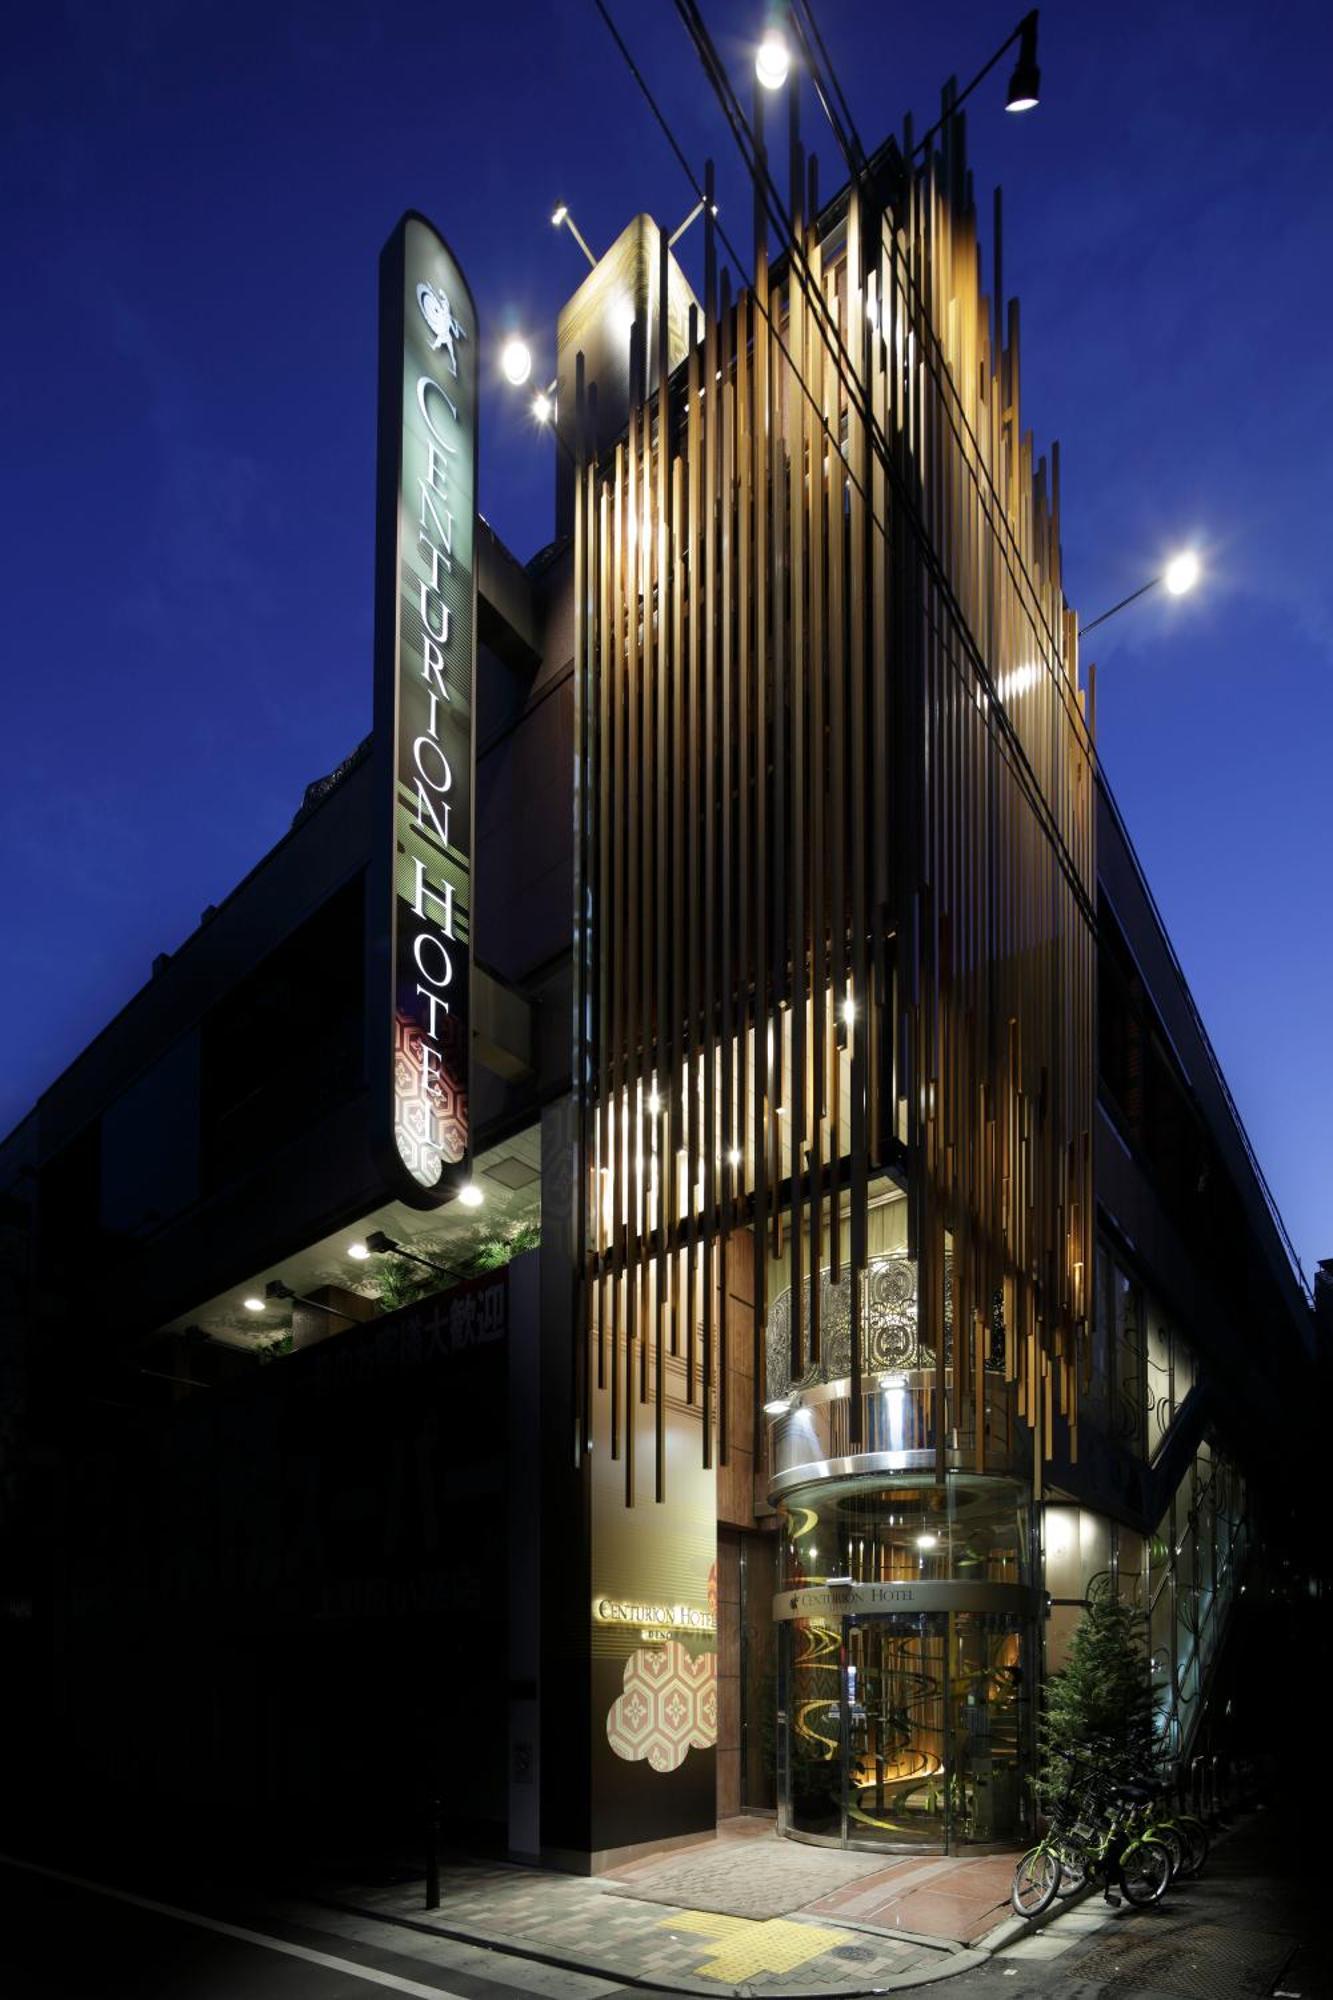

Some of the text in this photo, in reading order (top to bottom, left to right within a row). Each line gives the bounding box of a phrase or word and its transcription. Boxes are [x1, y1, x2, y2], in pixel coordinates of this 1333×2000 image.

[411, 375, 459, 1151] CENTURION HOTEL
[872, 1588, 915, 1602] HOTEL
[599, 1599, 717, 1628] CENTURION HOTEL
